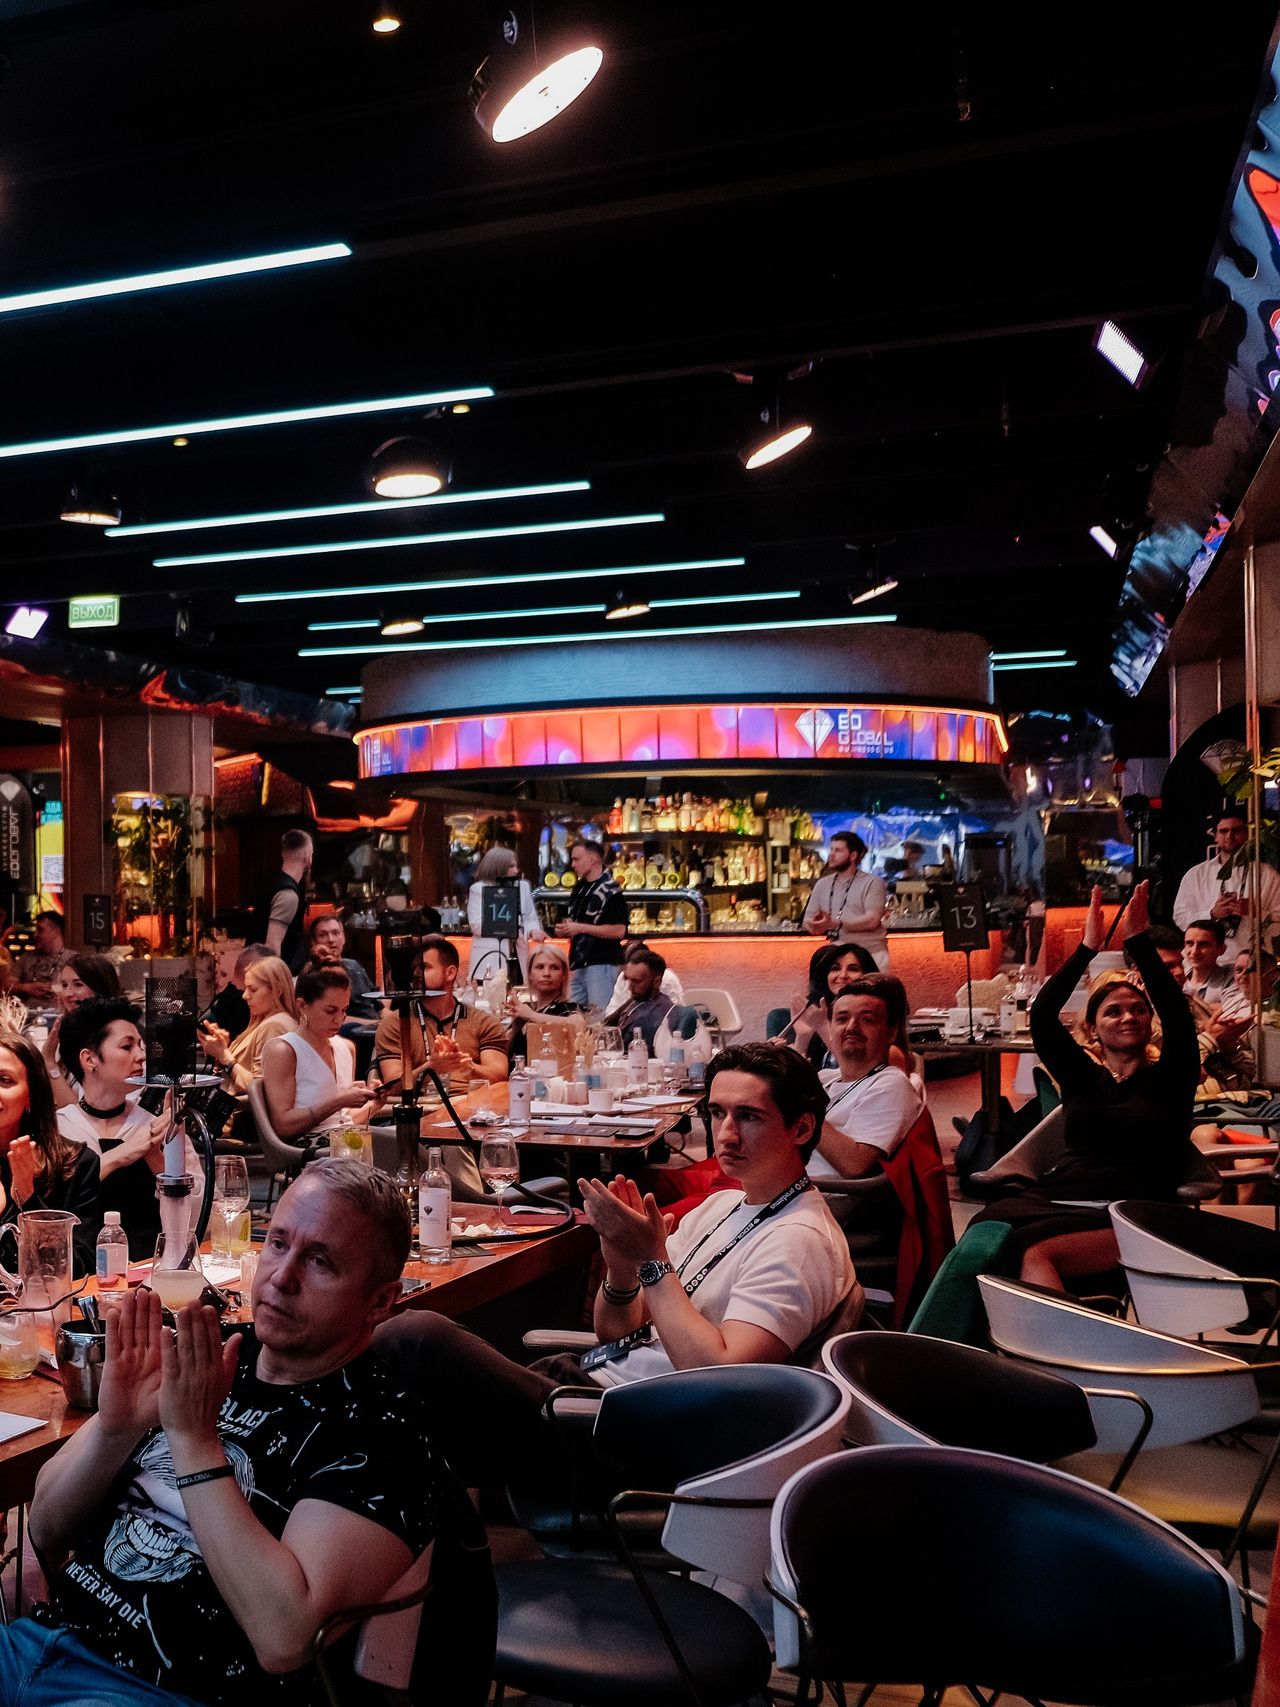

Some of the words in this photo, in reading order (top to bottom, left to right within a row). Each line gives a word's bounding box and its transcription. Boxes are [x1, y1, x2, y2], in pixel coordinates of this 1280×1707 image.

[72, 605, 114, 620] ВЫХОД
[837, 713, 862, 731] ED
[837, 731, 894, 746] GLOBAL
[90, 912, 105, 930] 15
[489, 904, 512, 922] 14
[950, 906, 977, 929] 13
[65, 1561, 101, 1593] NEVER
[96, 1586, 122, 1608] SAY
[118, 1602, 146, 1629] DIE
